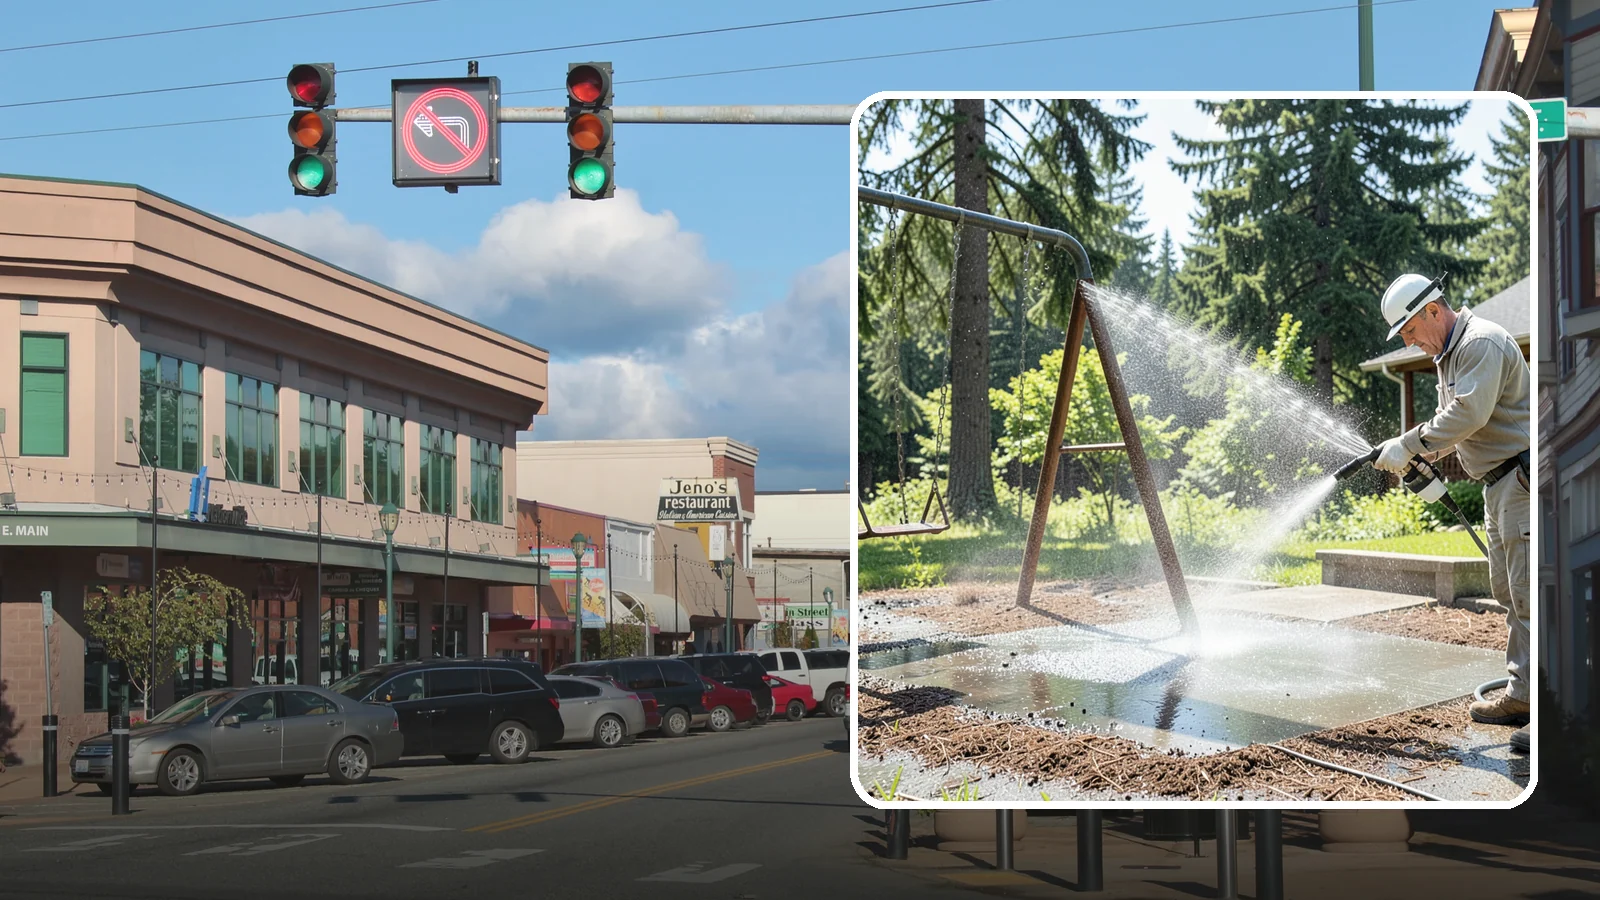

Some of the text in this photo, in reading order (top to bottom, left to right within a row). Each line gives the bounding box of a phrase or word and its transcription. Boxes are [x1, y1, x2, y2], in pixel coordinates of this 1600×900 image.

[669, 480, 727, 494] Jeno's
[665, 496, 731, 509] restaurant
[658, 510, 682, 519] Italian
[685, 509, 715, 519] American
[714, 509, 738, 520] Cuisine
[2, 525, 49, 536] E. MAIN
[797, 607, 829, 617] Street
[789, 619, 824, 627] lass
